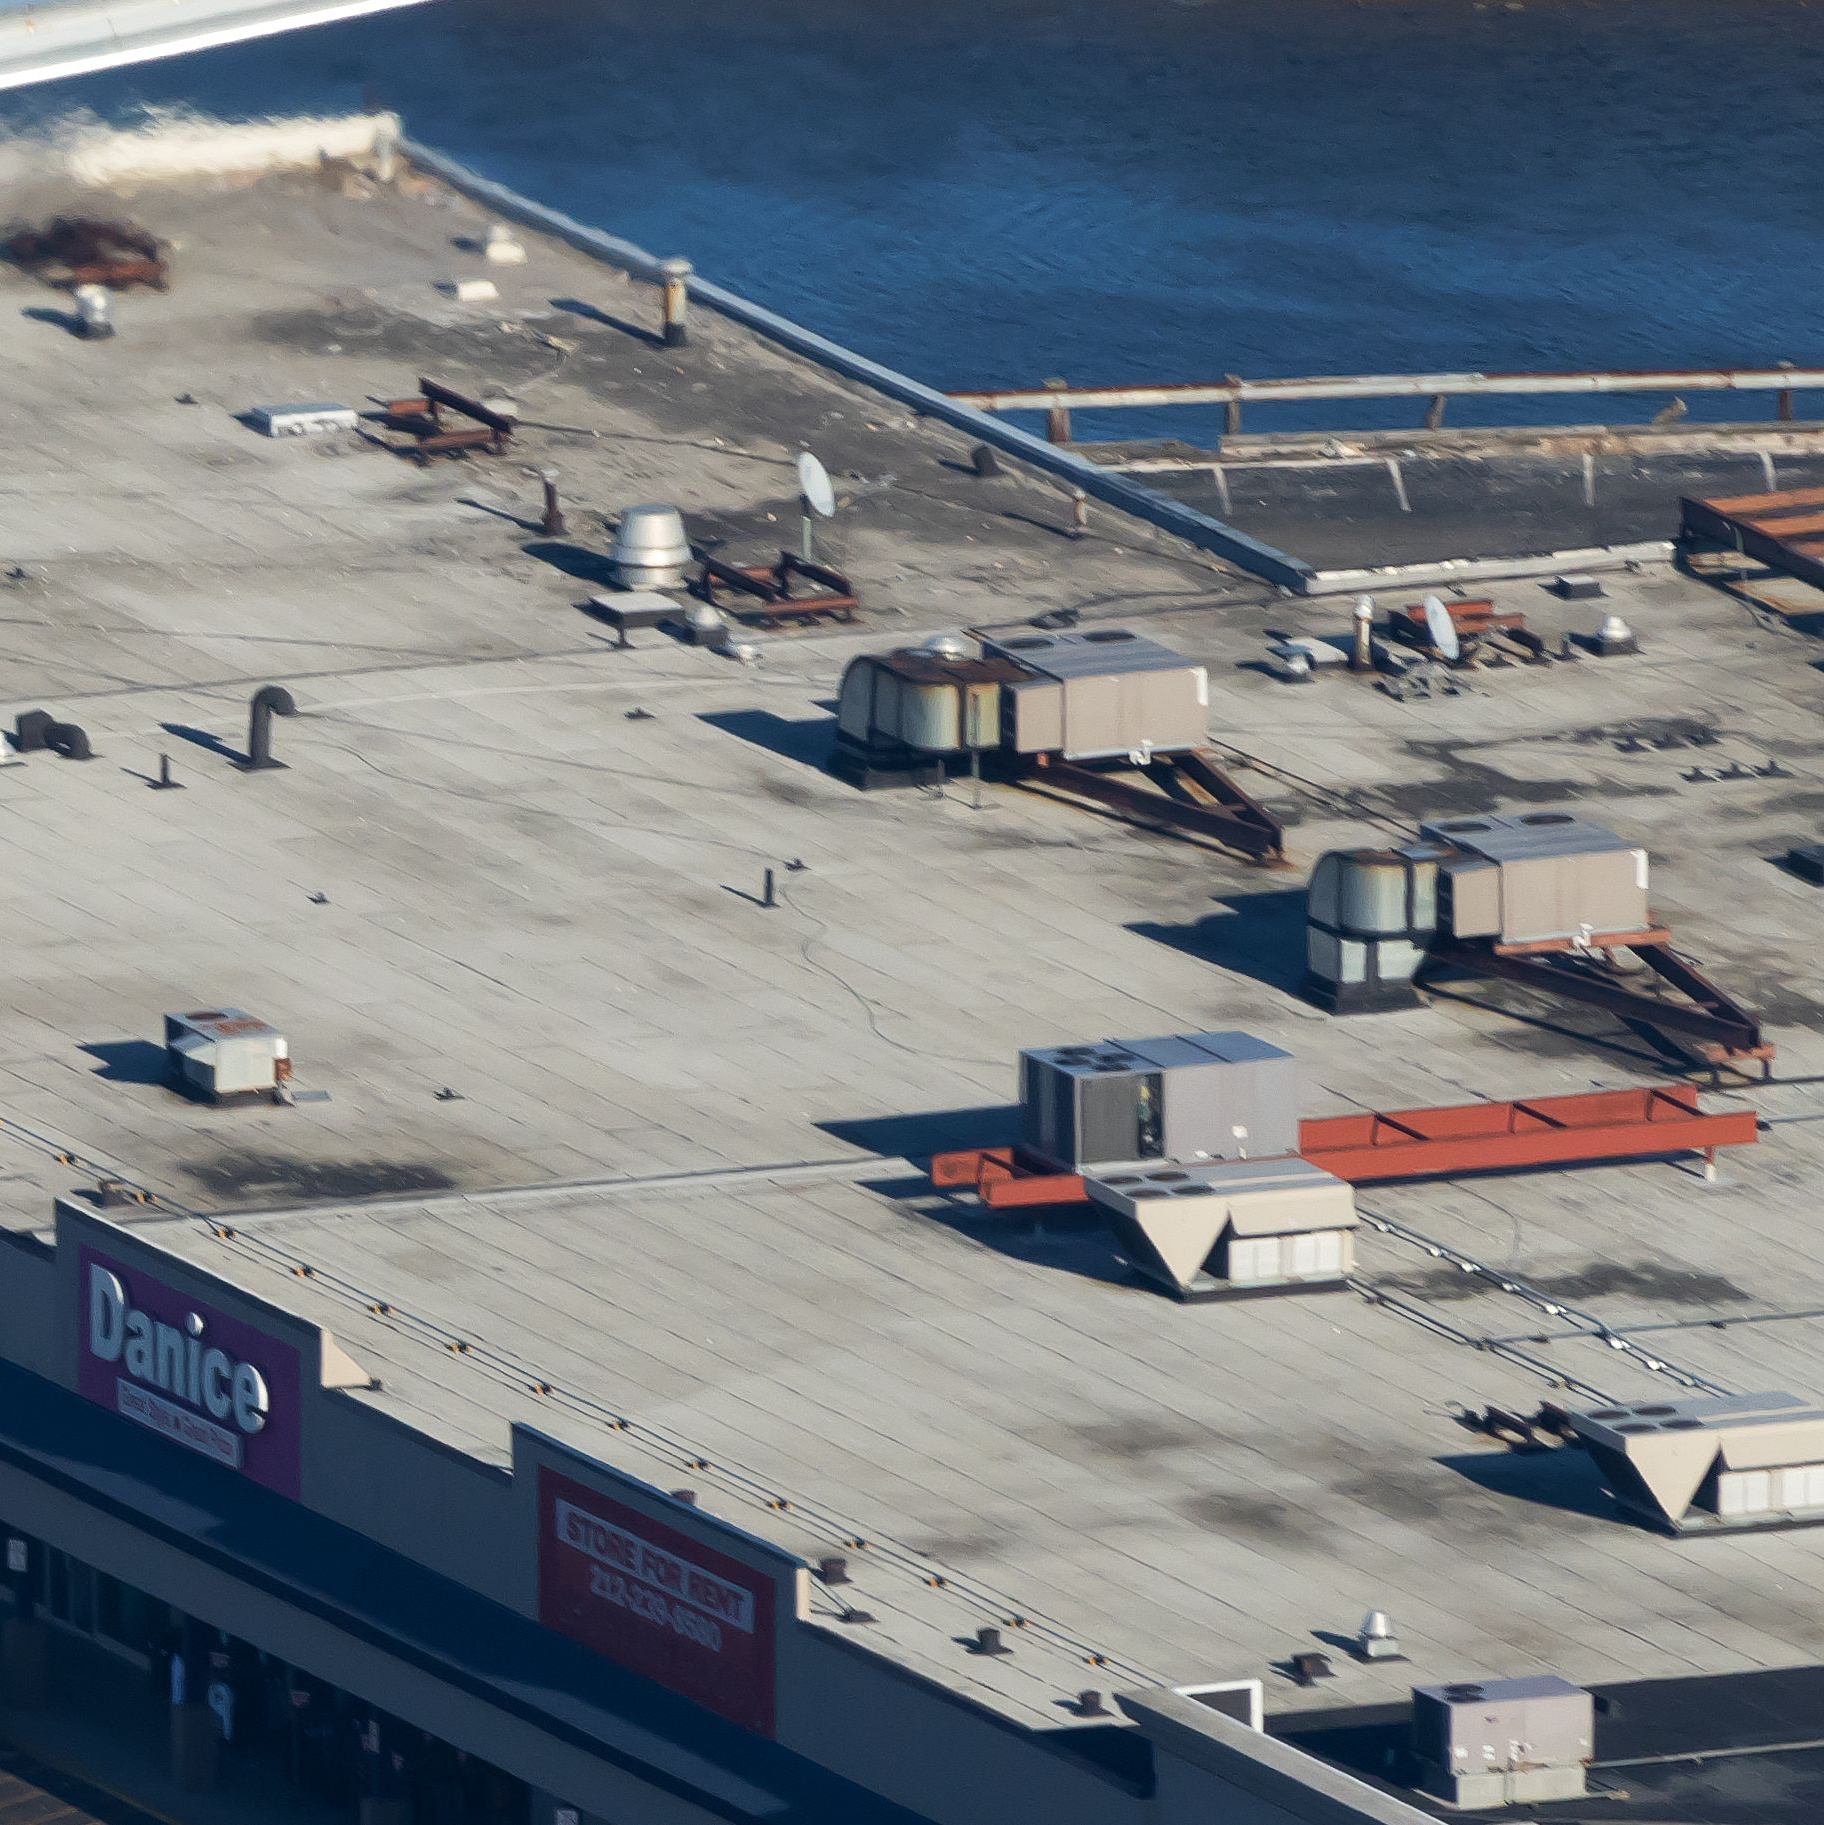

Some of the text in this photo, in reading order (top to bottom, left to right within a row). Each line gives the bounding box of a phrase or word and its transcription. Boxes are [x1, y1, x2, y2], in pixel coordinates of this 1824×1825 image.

[90, 1262, 269, 1434] Danice
[567, 1512, 745, 1623] STORE FOR RENT
